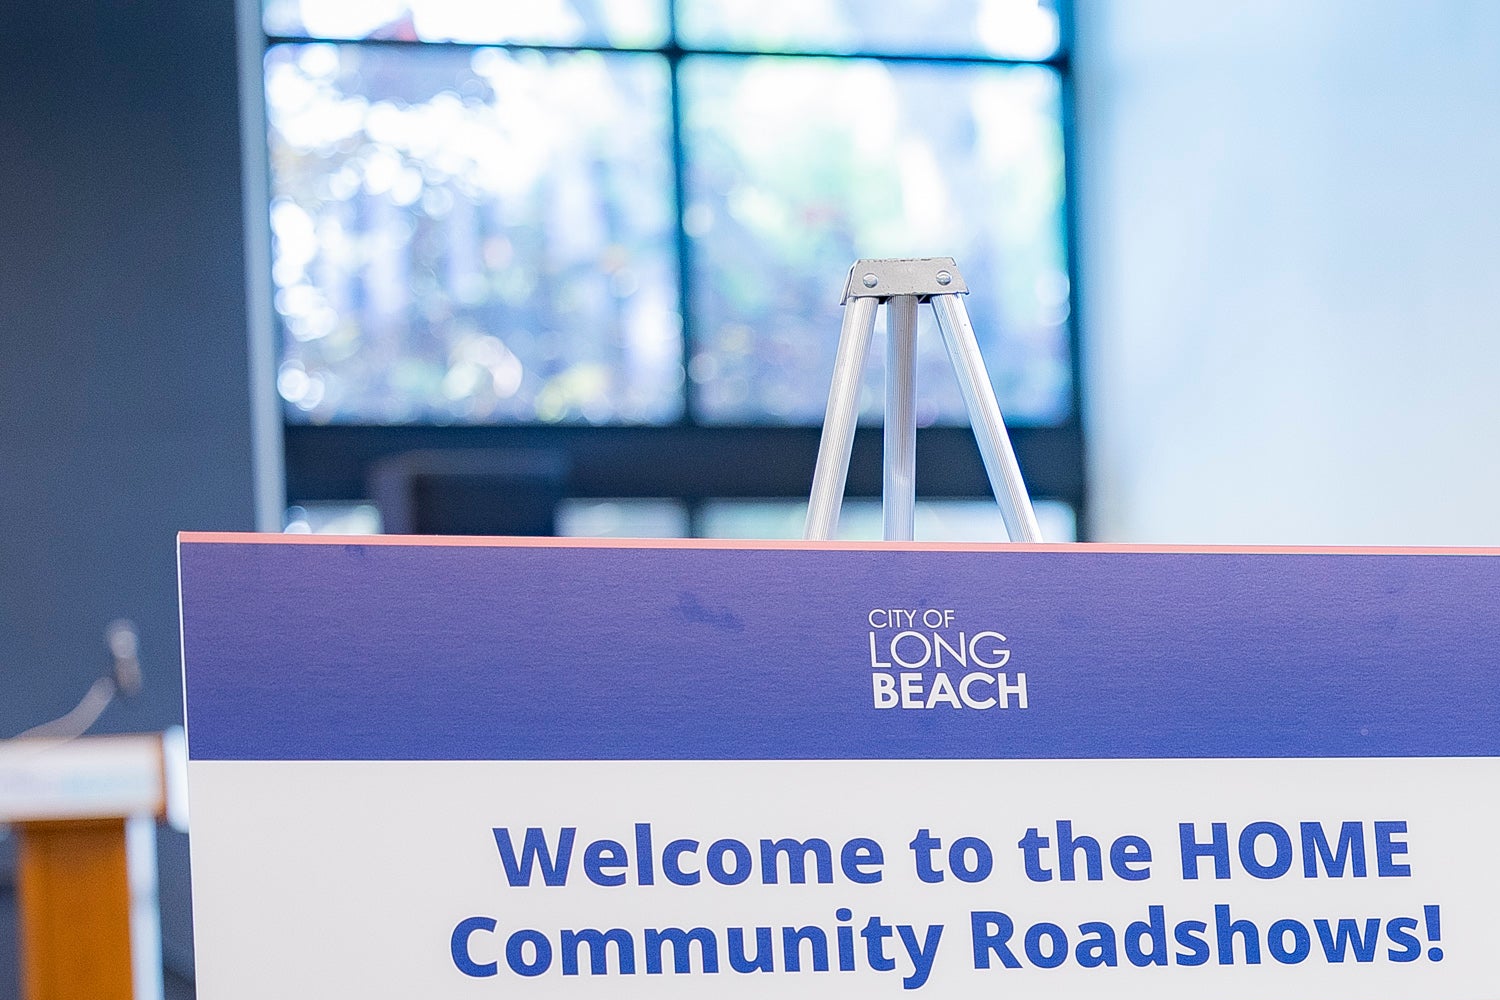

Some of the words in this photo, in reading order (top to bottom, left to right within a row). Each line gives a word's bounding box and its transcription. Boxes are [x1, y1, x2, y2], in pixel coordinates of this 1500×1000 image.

[868, 608, 917, 629] CITY
[922, 608, 955, 629] OF
[869, 630, 1011, 669] LONG
[872, 671, 1028, 710] BEACH
[491, 822, 885, 888] Welcome
[908, 828, 994, 884] to
[1017, 819, 1153, 883] the
[1178, 820, 1412, 881] HOME
[450, 907, 945, 991] Community
[970, 903, 1444, 970] Roadshows!
